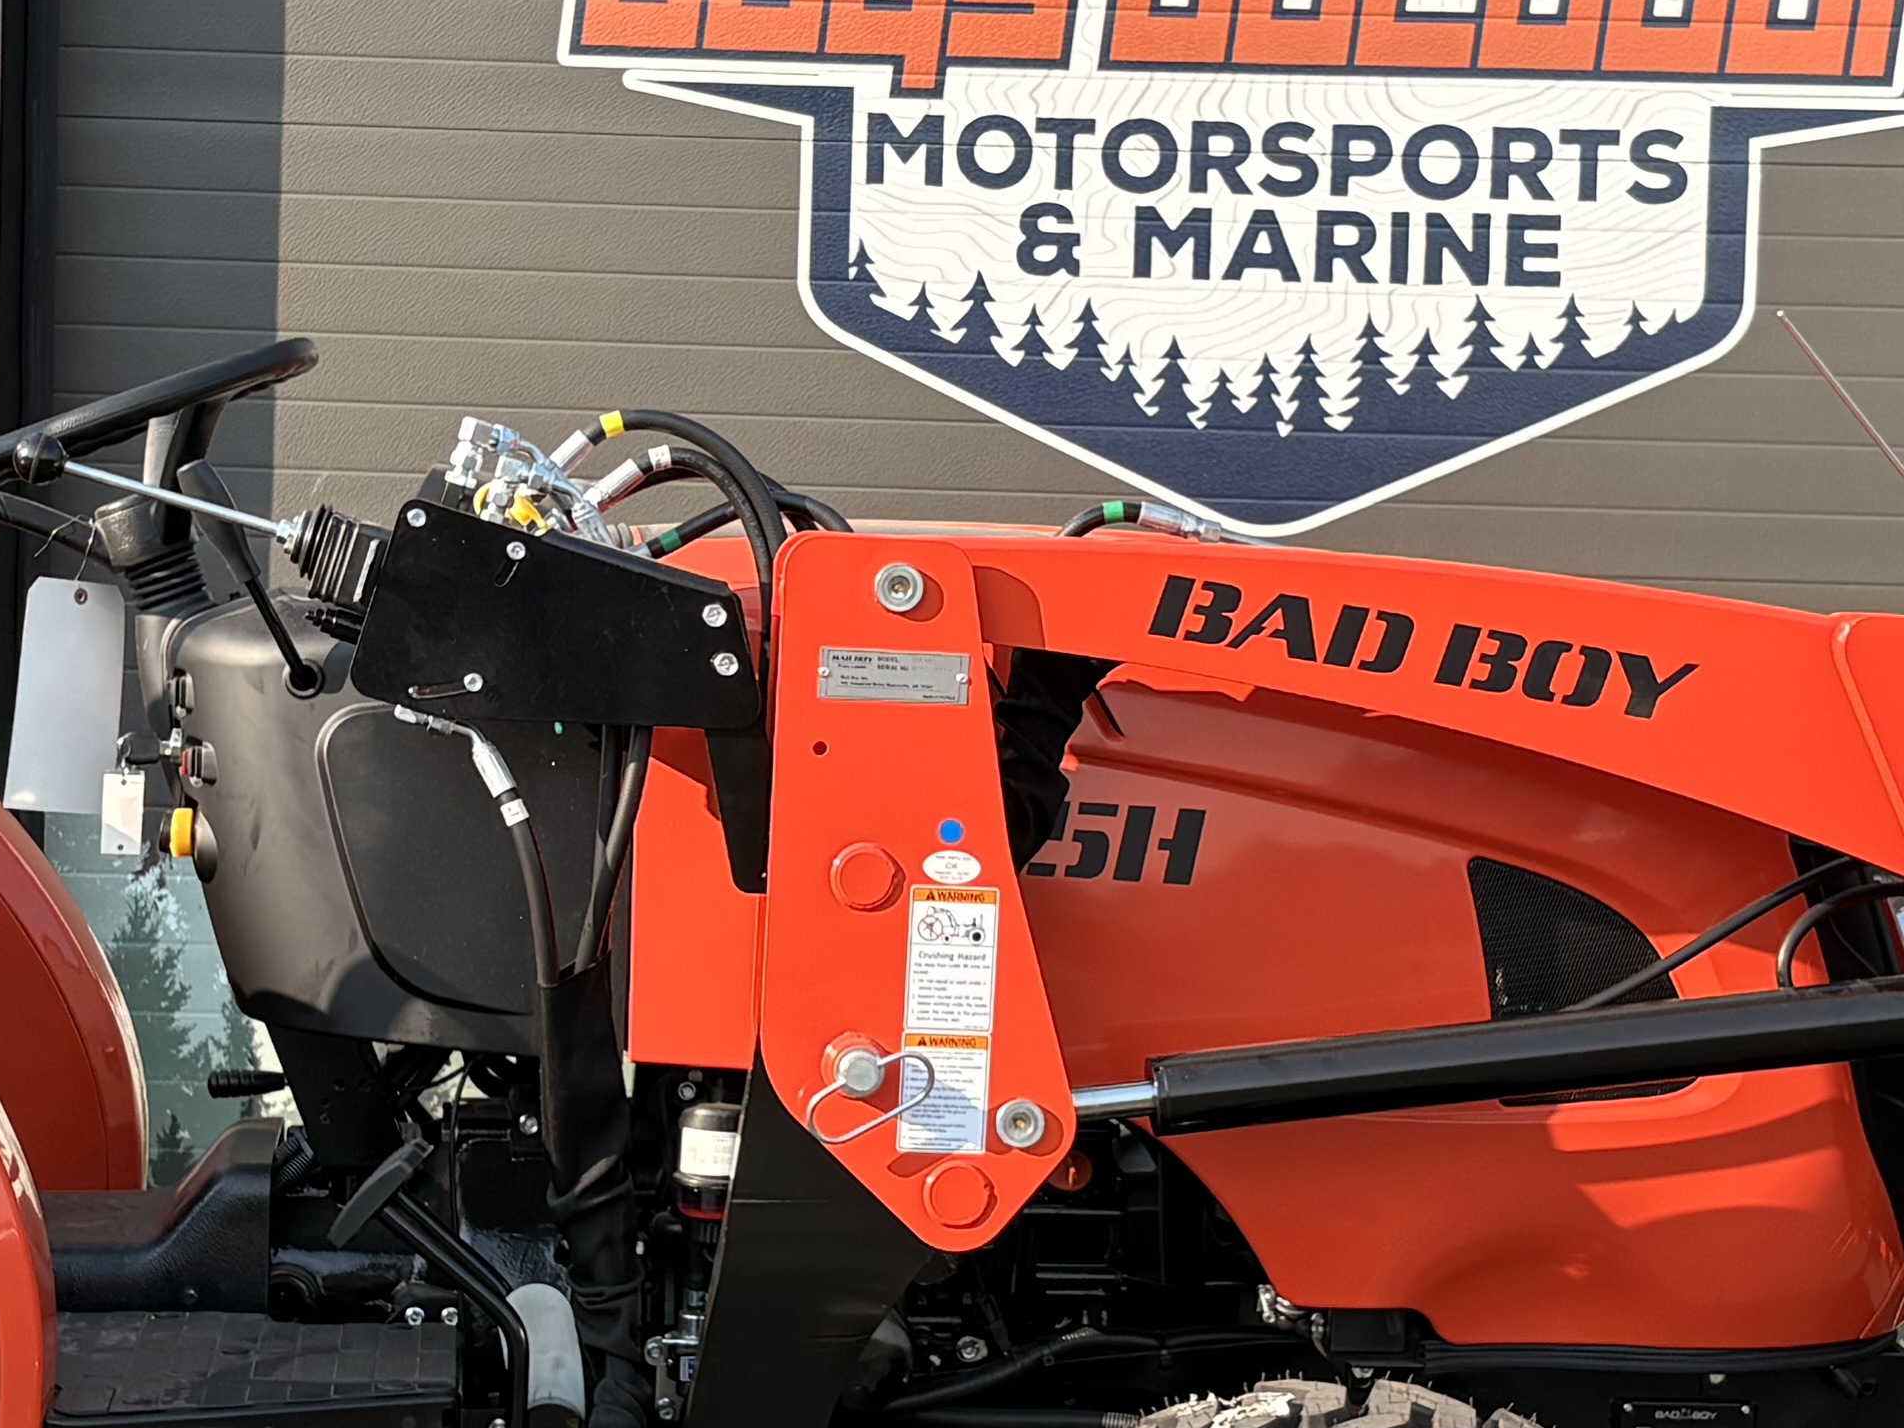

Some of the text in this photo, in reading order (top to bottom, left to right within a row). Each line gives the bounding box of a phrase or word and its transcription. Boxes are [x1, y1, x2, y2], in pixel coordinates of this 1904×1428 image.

[866, 112, 1690, 203] MOTORSPORTS
[1017, 204, 1562, 287] & MARINE
[1148, 574, 1700, 719] BAD BOY
[937, 891, 985, 903] WARNING
[918, 951, 986, 962] Crushing Hazard
[929, 1037, 977, 1048] WARNING
